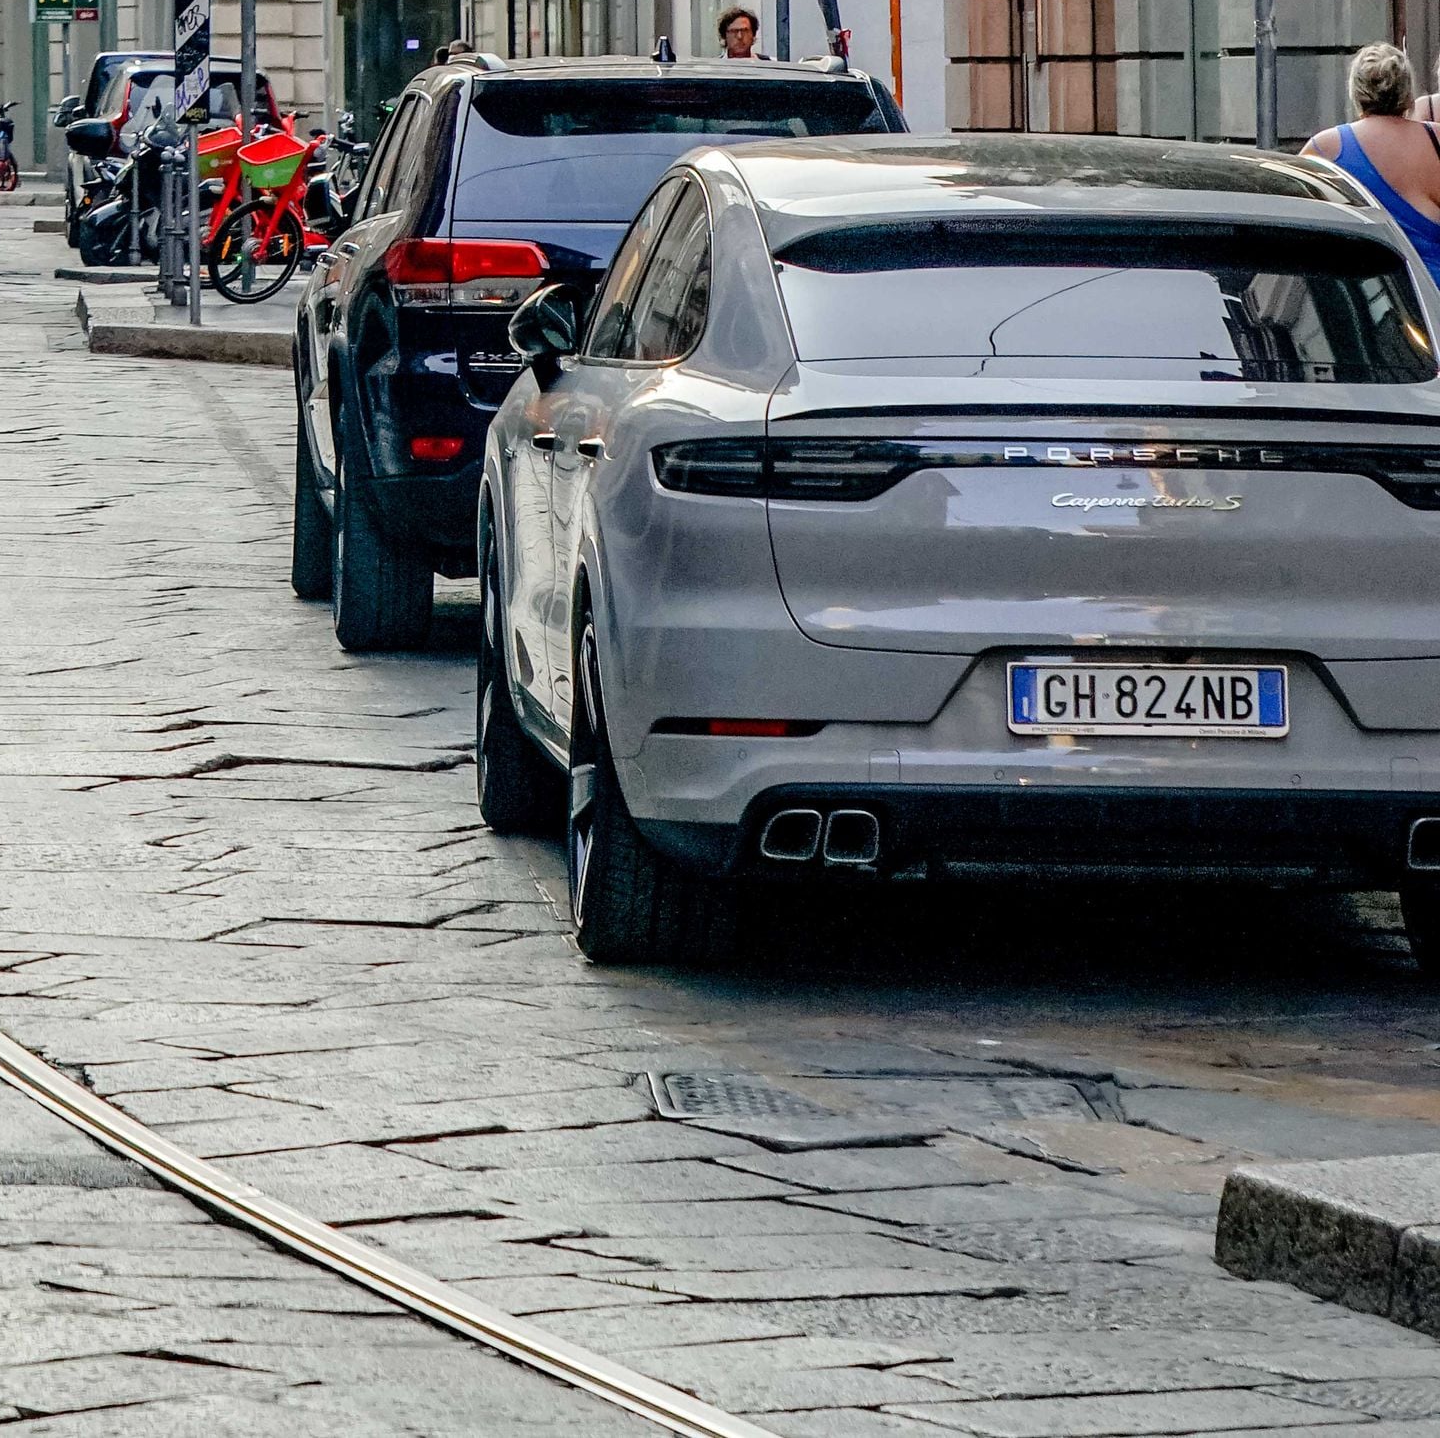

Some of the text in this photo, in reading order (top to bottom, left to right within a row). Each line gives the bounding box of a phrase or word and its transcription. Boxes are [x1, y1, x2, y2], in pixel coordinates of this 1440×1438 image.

[1004, 446, 1284, 464] PORSCHE
[1051, 492, 1146, 512] Cayenne
[1212, 495, 1244, 511] S
[1044, 674, 1254, 720] GH 824NB
